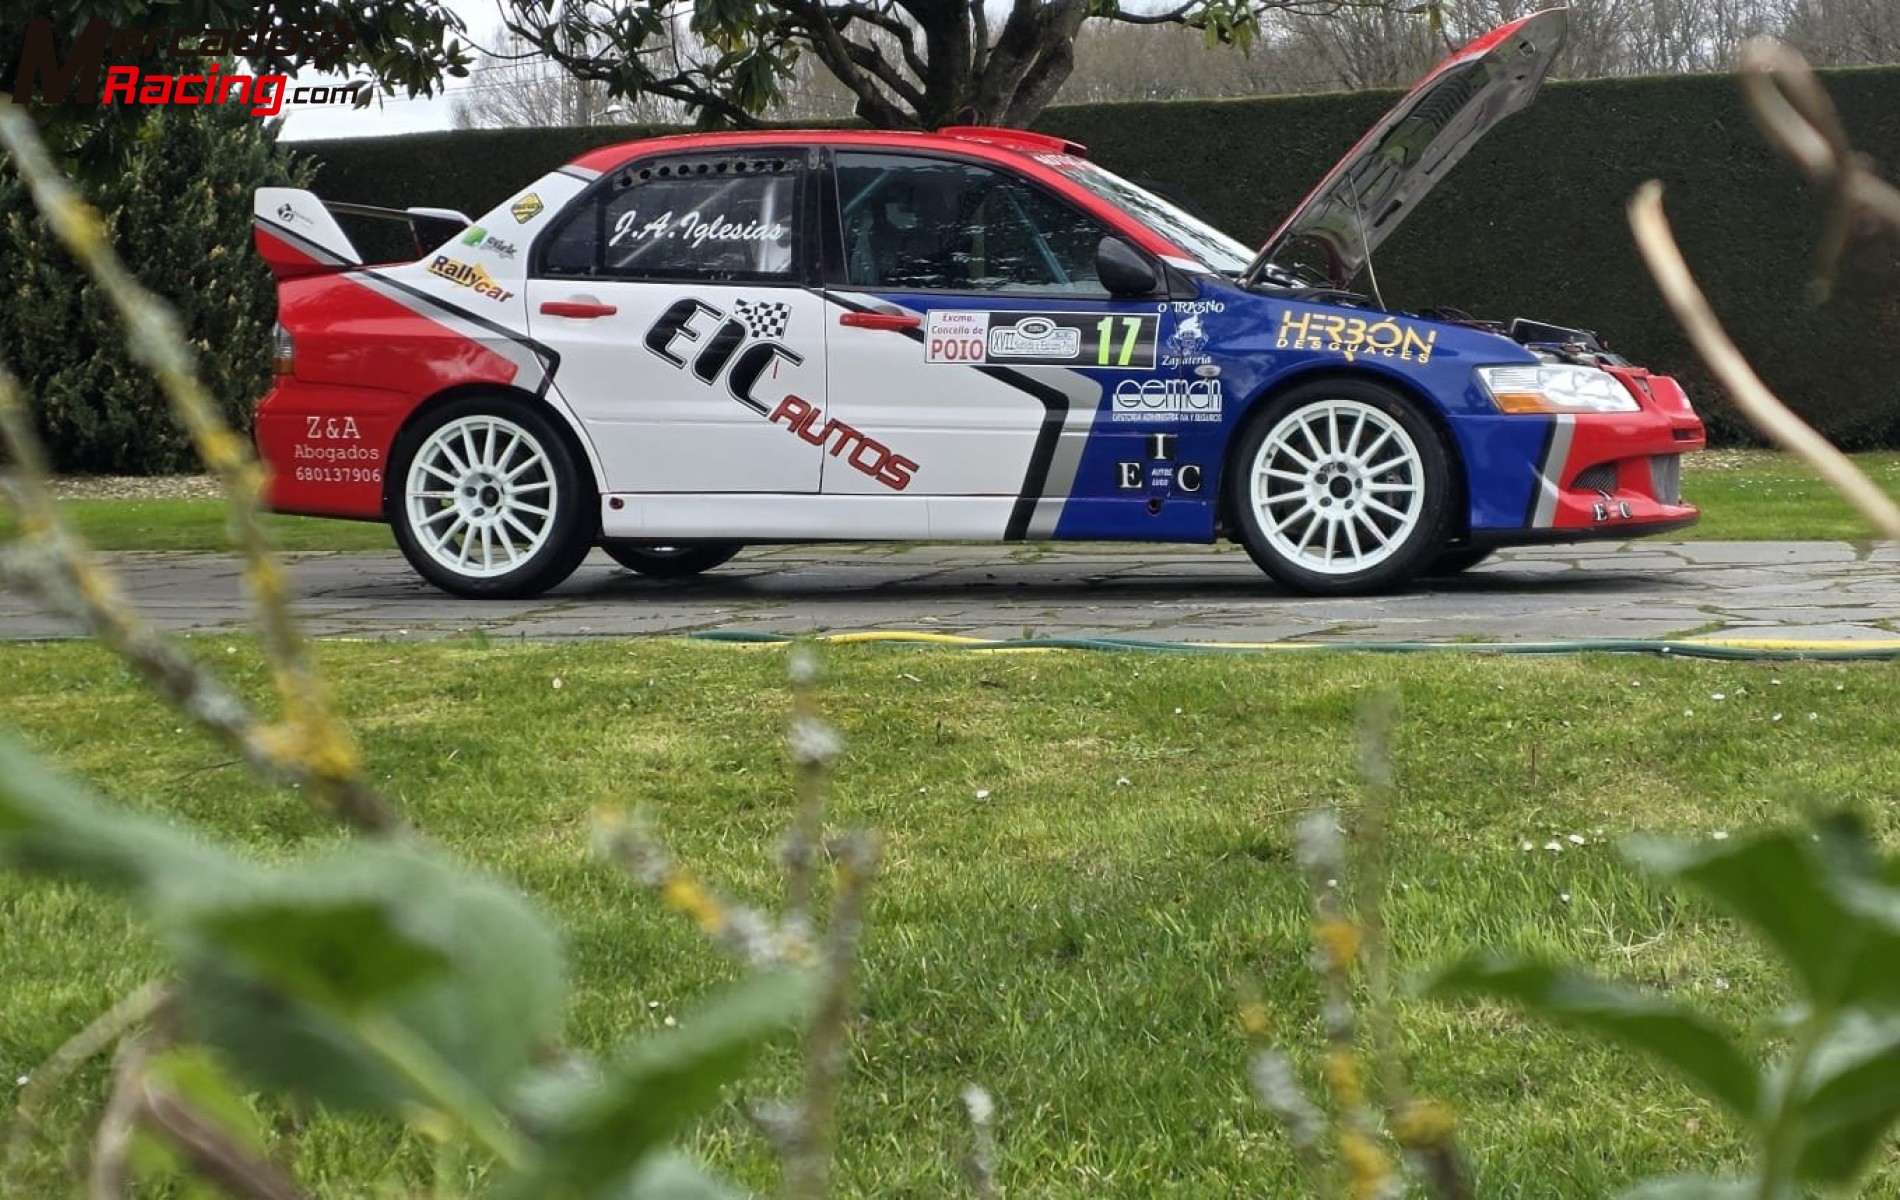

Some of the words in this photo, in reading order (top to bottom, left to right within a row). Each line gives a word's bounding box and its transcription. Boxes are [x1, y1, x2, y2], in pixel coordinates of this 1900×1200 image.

[429, 255, 515, 303] Rallycar
[931, 339, 984, 361] POIO
[1096, 315, 1142, 367] 17
[1276, 338, 1431, 363] DESGUACES
[642, 297, 805, 417] EIC
[306, 416, 362, 439] Z&A
[294, 444, 380, 462] Abogados
[769, 394, 920, 491] AUTOS
[295, 467, 381, 482] 680137906
[1118, 462, 1142, 488] E
[1177, 465, 1201, 492] C
